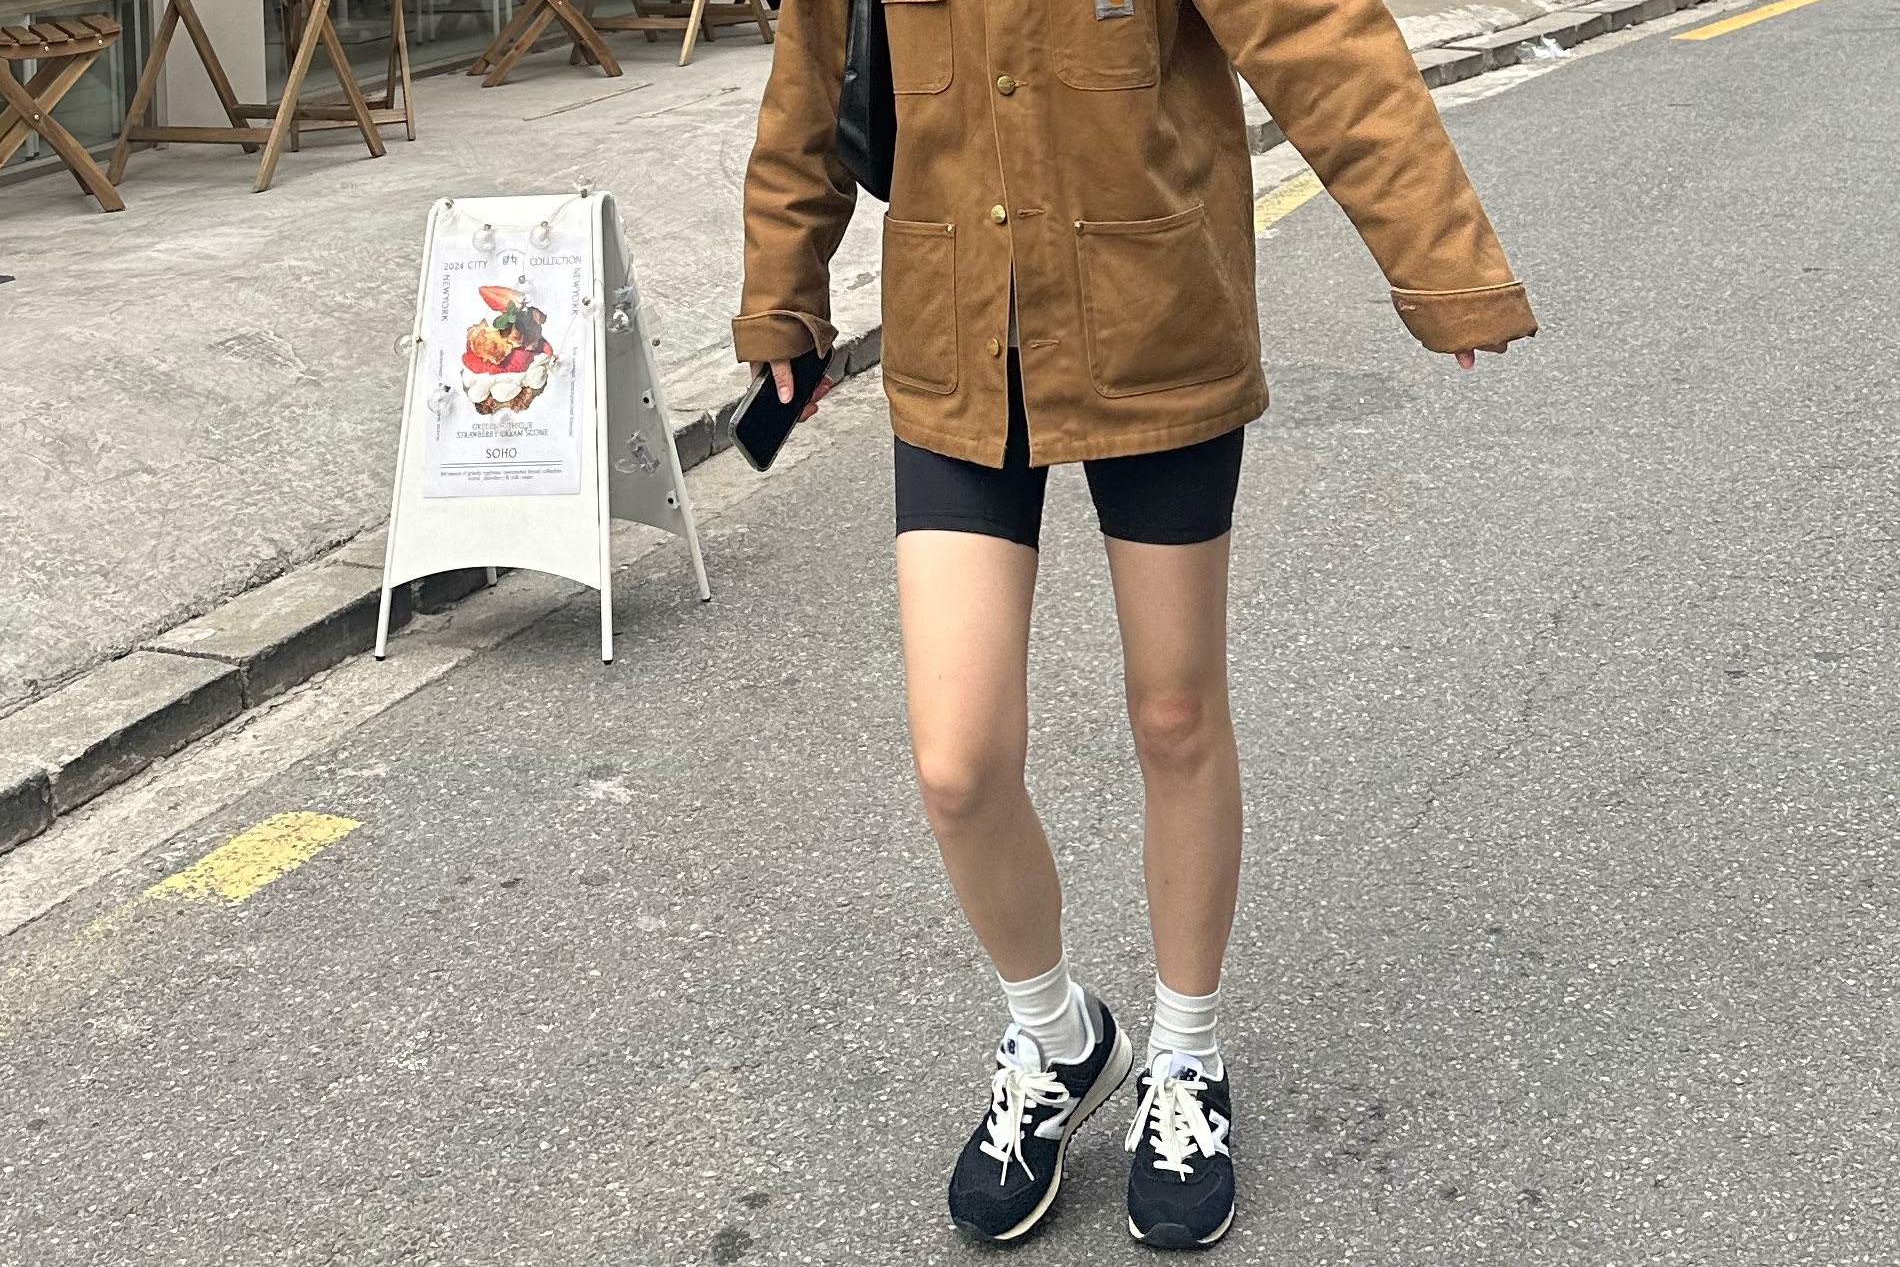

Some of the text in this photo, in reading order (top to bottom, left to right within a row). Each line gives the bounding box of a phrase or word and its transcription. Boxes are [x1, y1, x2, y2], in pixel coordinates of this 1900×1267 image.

[443, 260, 489, 271] 2024 CITY
[530, 256, 582, 266] COLLECTION
[485, 447, 518, 459] SOHO
